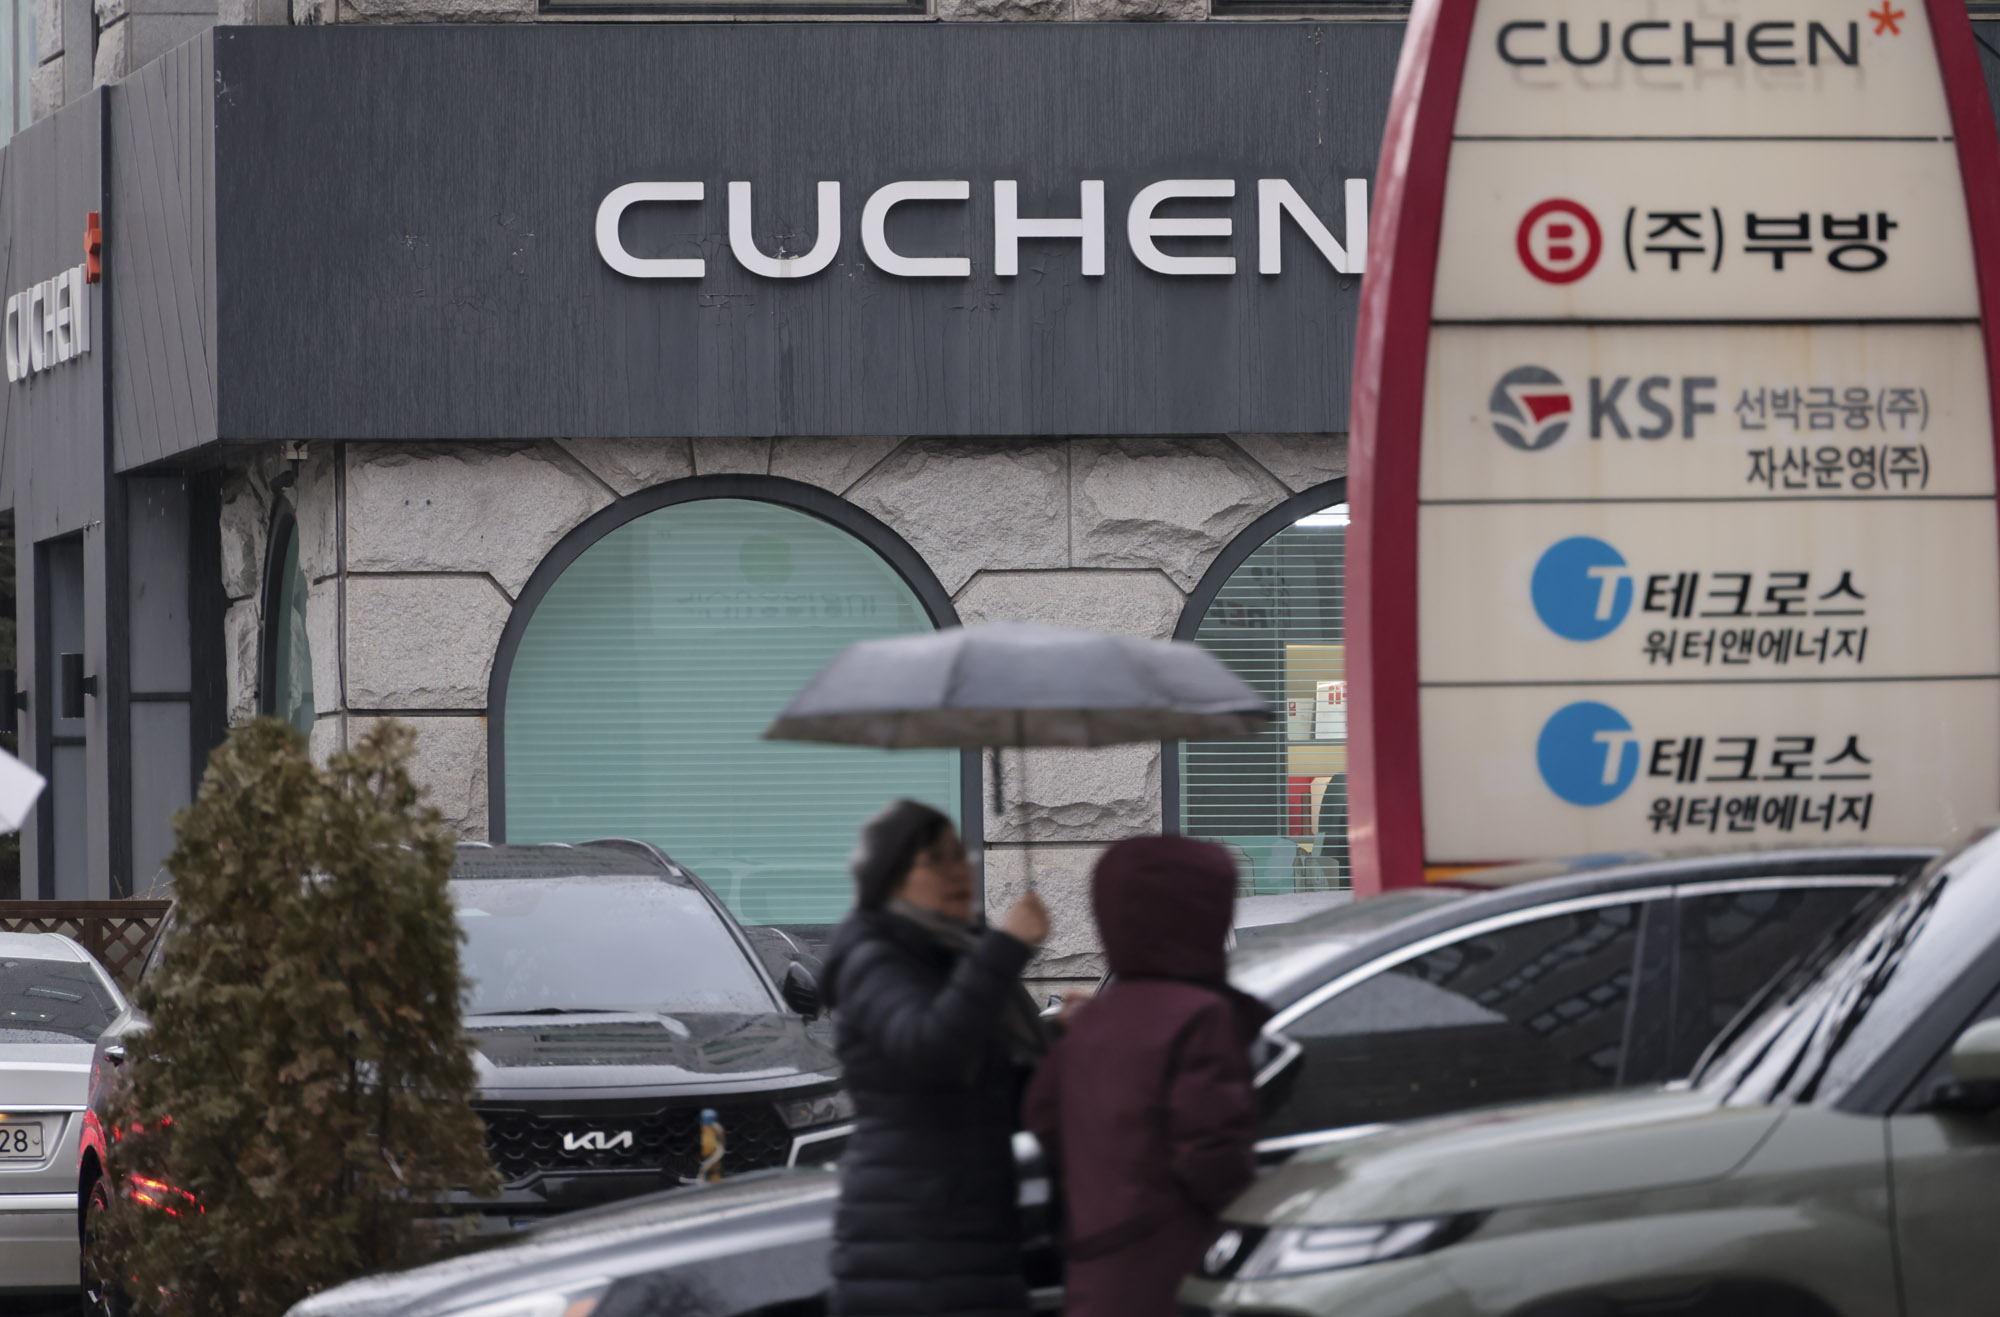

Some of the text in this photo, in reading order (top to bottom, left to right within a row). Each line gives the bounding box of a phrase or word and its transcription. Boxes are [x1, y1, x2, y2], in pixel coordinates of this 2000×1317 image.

[1496, 21, 1858, 66] CUCHEN
[596, 179, 1368, 277] CUCHEN
[1624, 207, 1724, 272] (주)
[1743, 211, 1898, 273] 부방
[1588, 375, 1930, 441] KSF 선박금융(주)
[1747, 444, 1930, 490] 자산운영(주)
[1642, 570, 1866, 619] 테크로스
[1643, 626, 1868, 665] 워터앤에너지
[1648, 735, 1872, 784] 테크로스
[1647, 792, 1873, 834] 워터앤에너지
[563, 1131, 633, 1150] KIA
